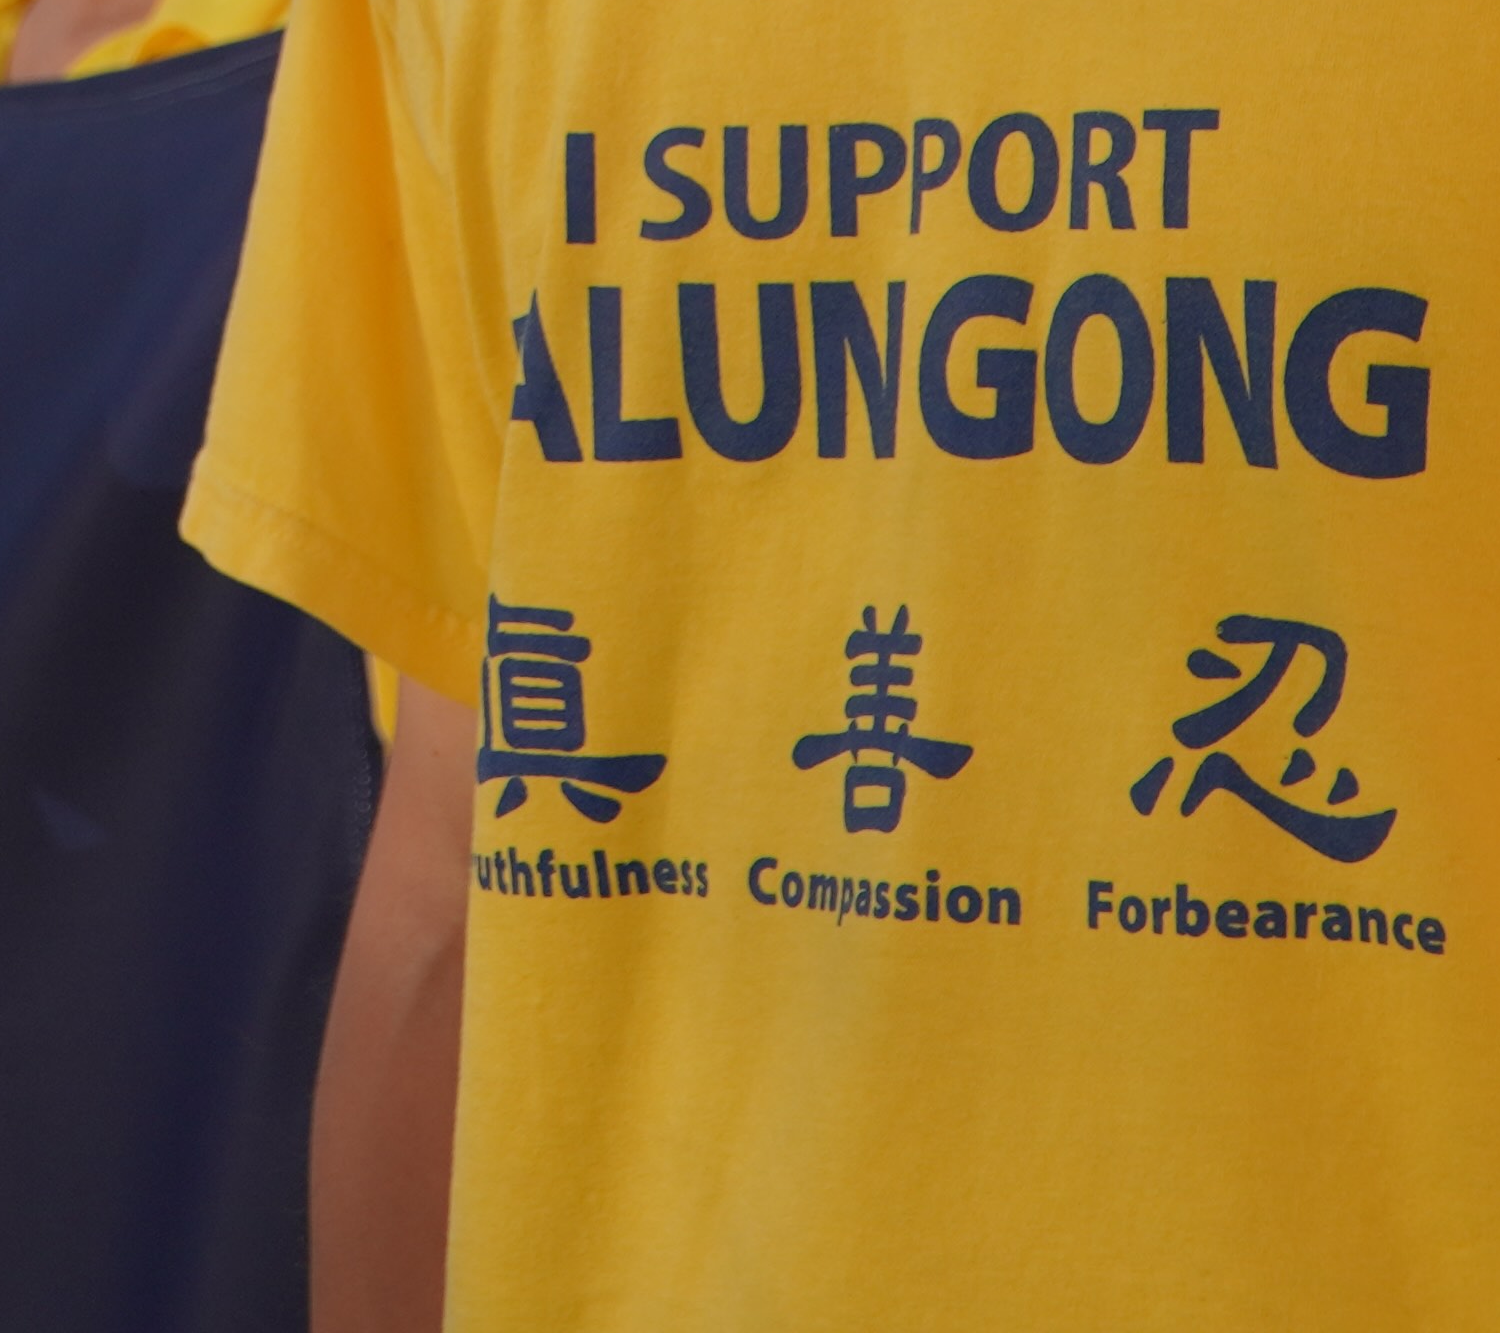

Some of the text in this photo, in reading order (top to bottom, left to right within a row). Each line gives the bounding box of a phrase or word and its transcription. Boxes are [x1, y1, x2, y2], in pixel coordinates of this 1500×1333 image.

[564, 107, 1220, 244] I SUPPORT
[509, 272, 1431, 480] ALUNGONG
[791, 604, 973, 834] 善
[1129, 612, 1398, 864] 忍
[472, 846, 1446, 956] uthfulness Compassion Forbearance
